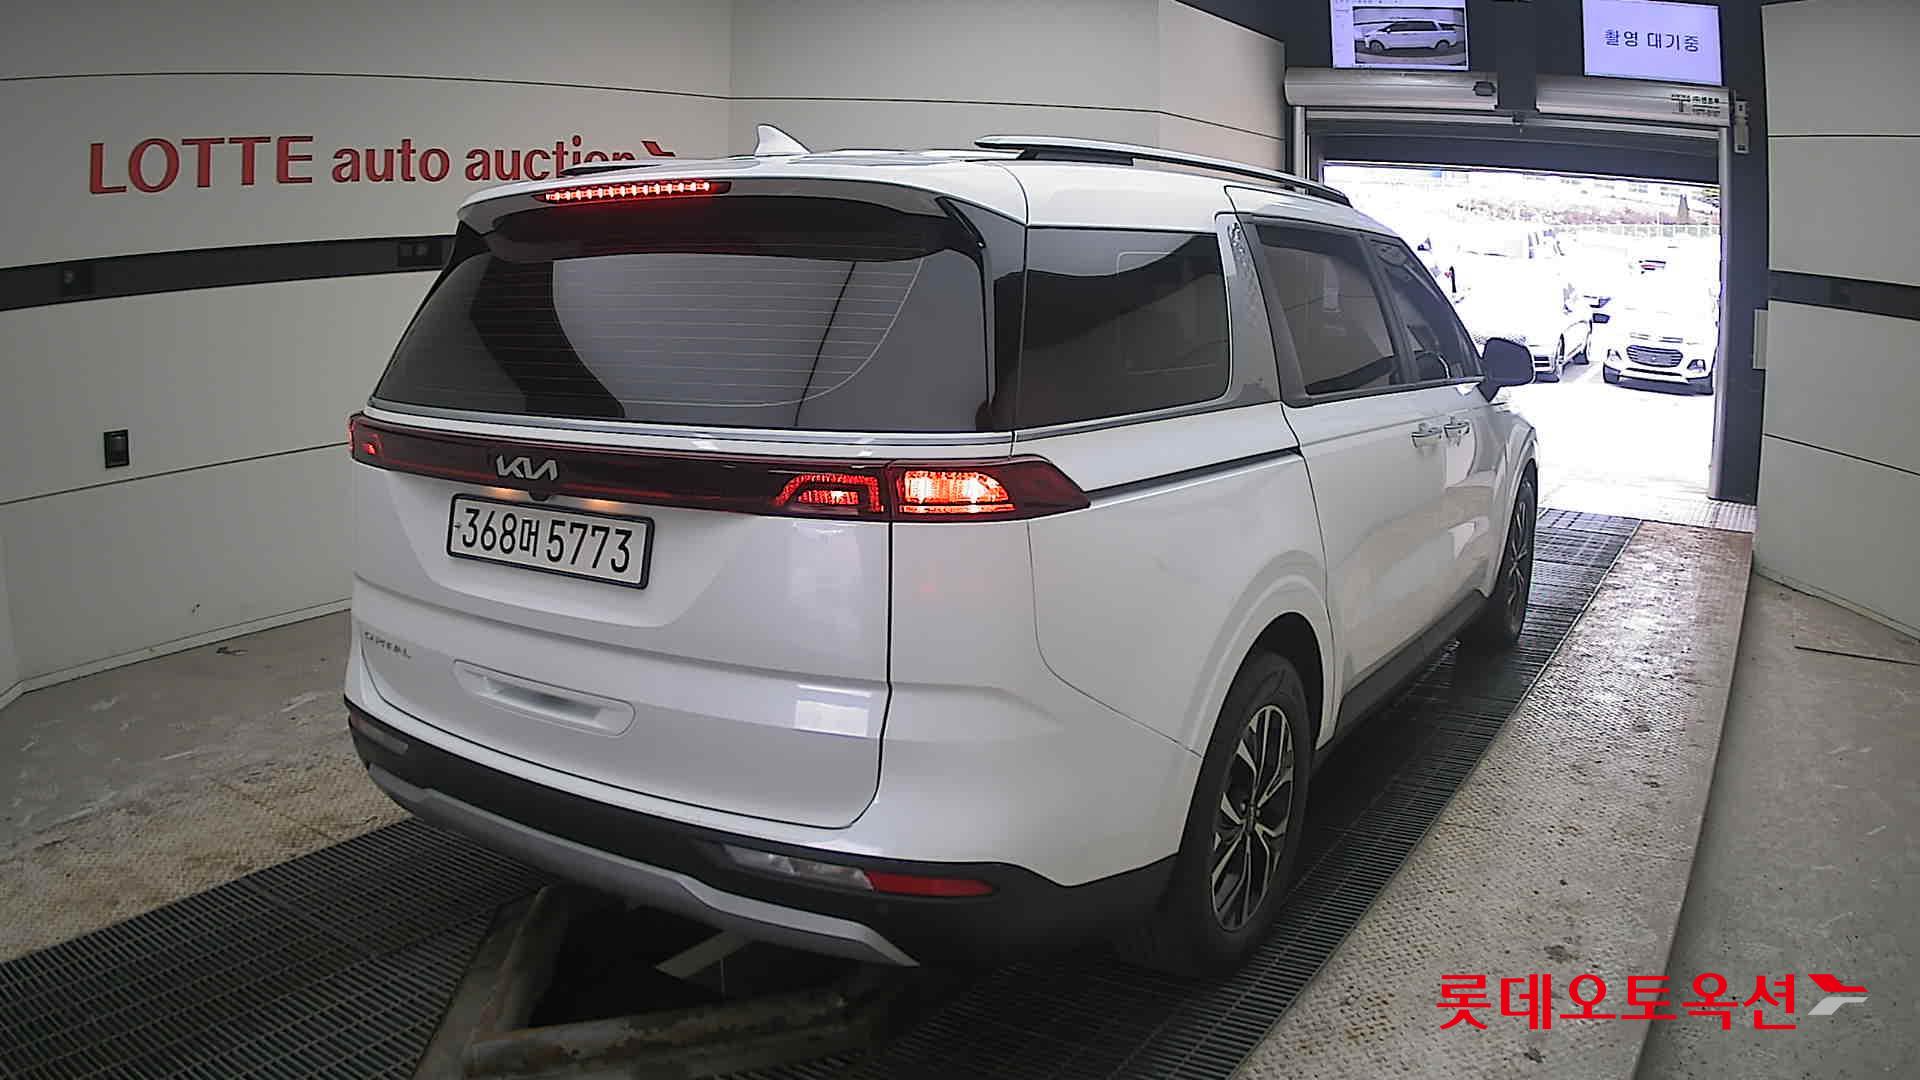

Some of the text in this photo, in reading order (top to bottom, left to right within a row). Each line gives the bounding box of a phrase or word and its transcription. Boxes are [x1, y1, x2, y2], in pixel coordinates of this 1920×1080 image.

[1647, 32, 1699, 52] 대기중
[89, 135, 314, 194] LOTTE
[332, 138, 450, 183] auto
